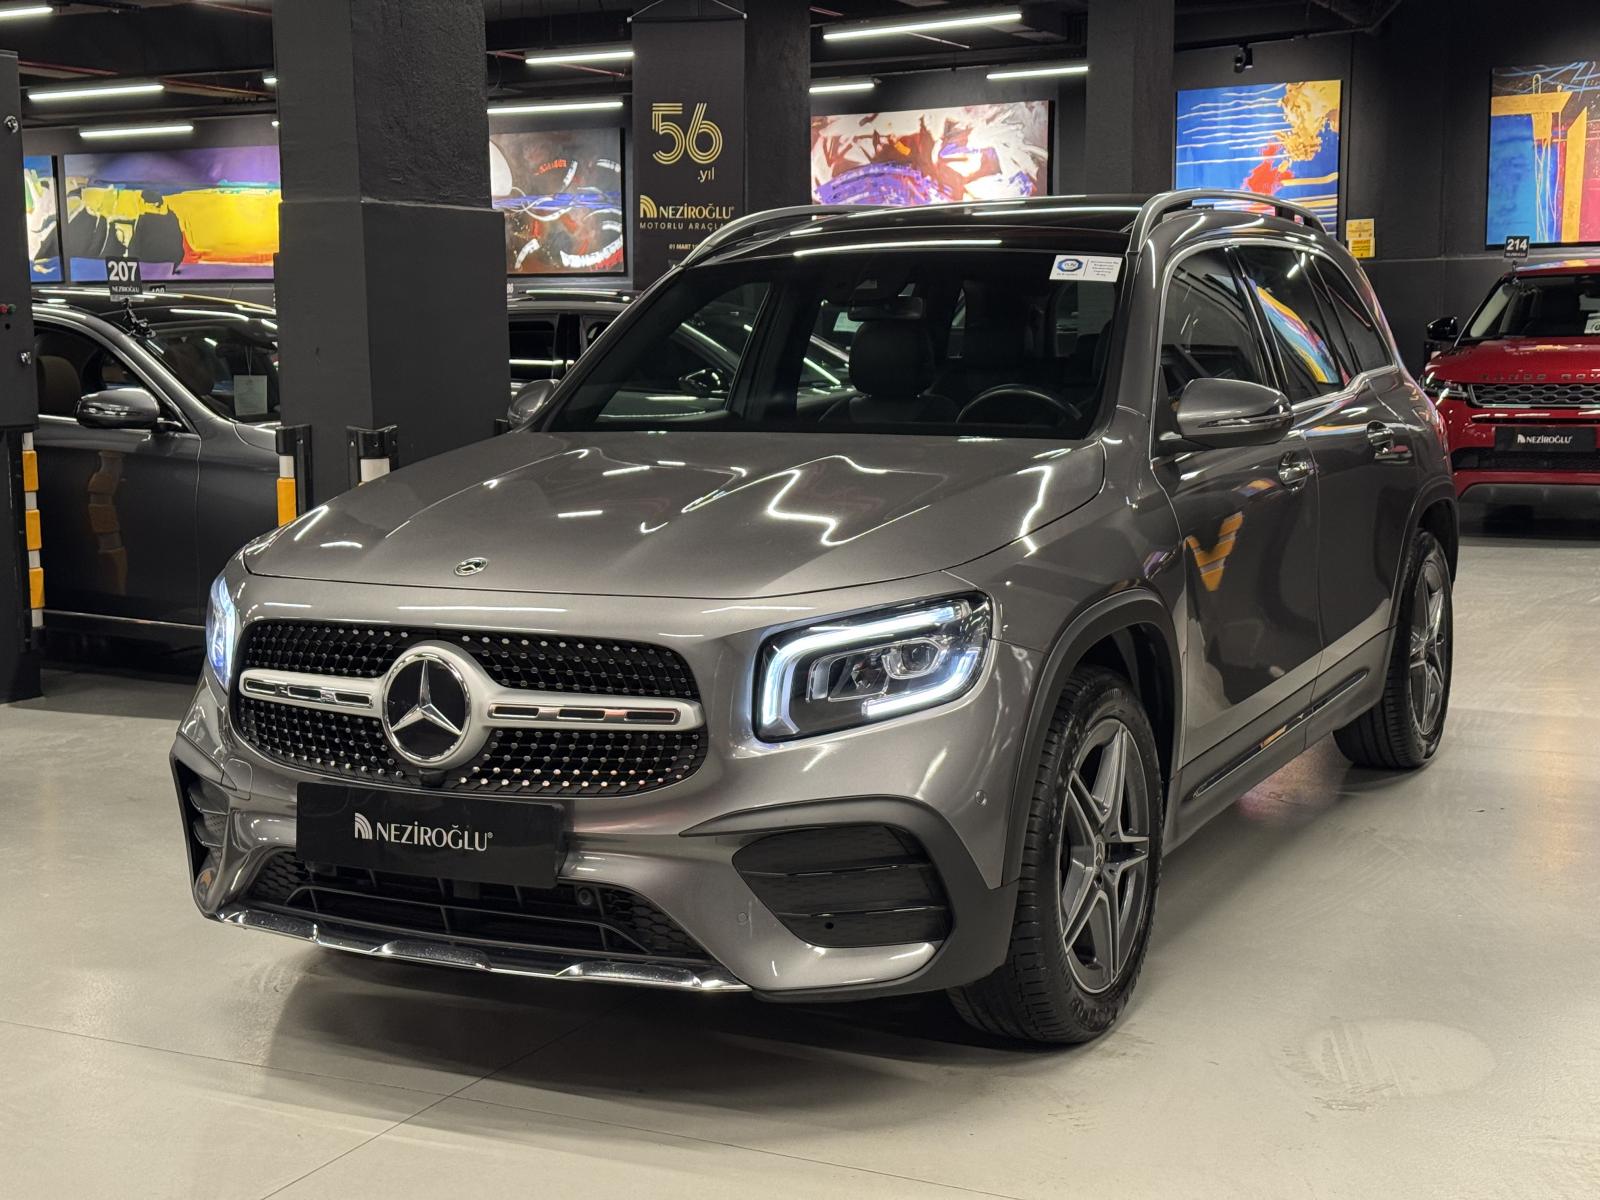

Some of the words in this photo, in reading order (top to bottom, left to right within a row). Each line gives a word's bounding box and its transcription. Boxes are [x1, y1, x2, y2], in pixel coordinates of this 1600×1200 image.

[652, 102, 723, 165] 56
[659, 203, 731, 219] NEZİROĞLU
[640, 222, 684, 230] MOTORLU
[688, 222, 725, 231] ARAÇLA
[1506, 238, 1527, 250] 214
[107, 260, 138, 281] 207
[376, 820, 489, 851] NEZİROĞLU
